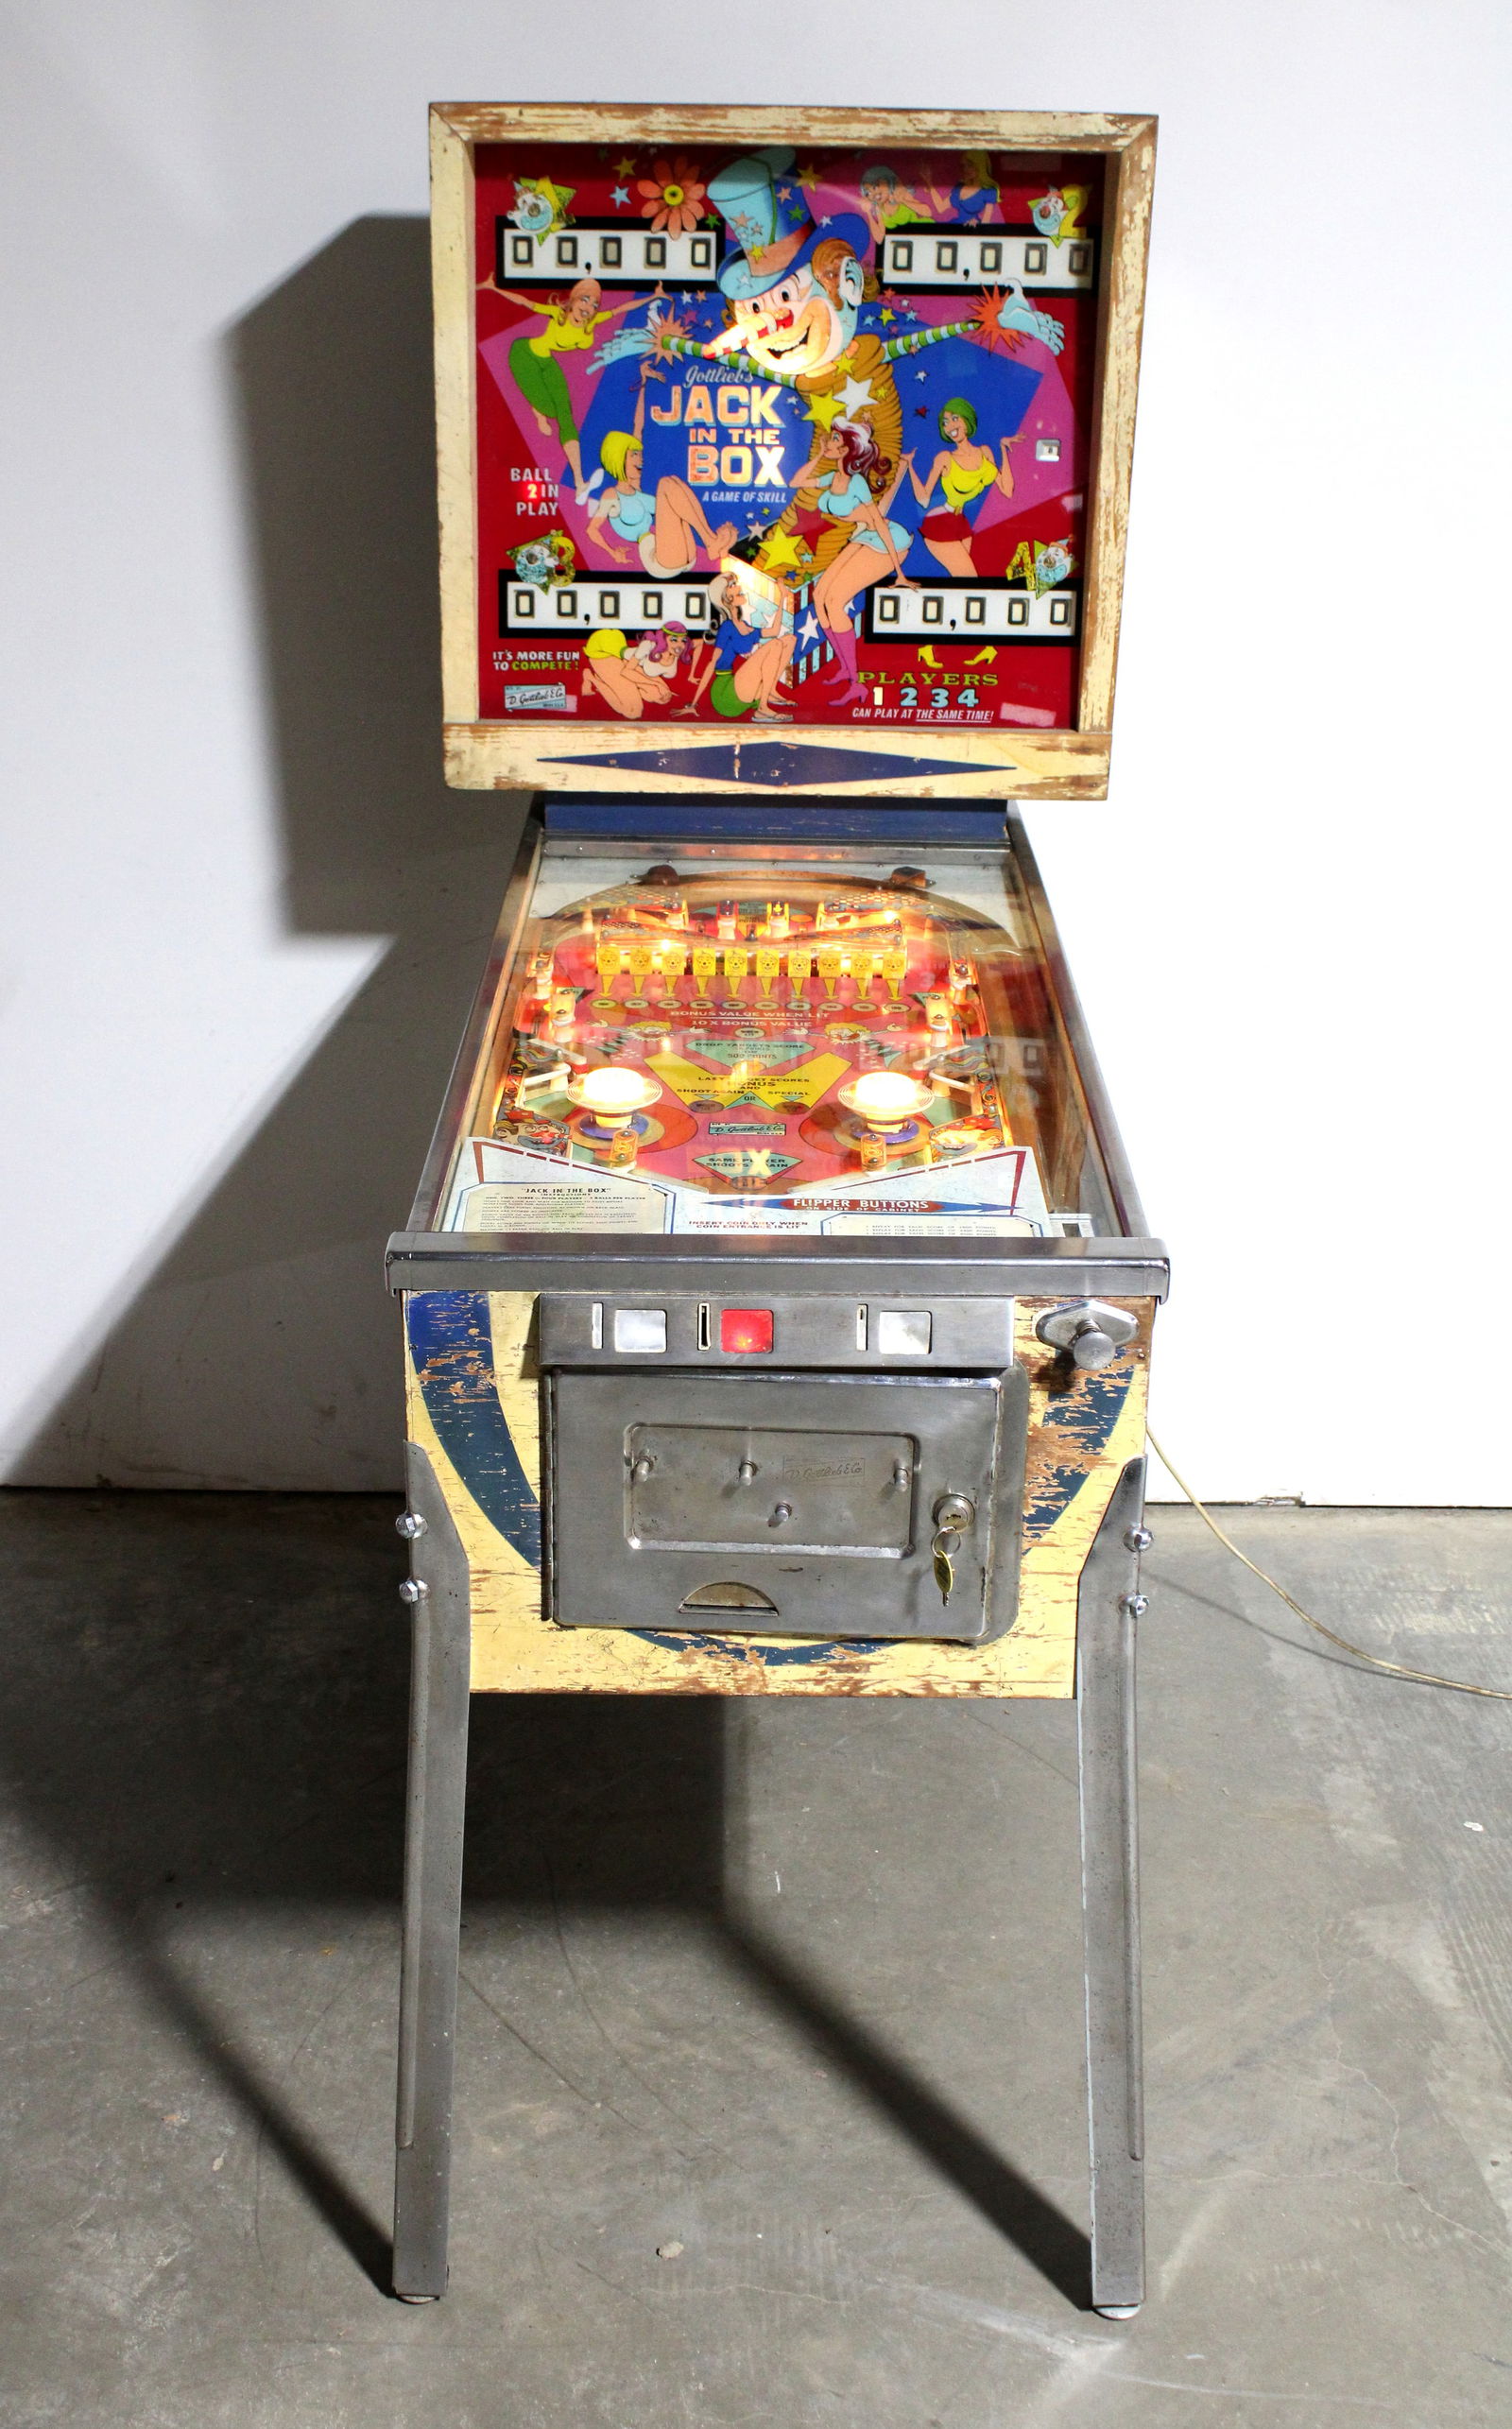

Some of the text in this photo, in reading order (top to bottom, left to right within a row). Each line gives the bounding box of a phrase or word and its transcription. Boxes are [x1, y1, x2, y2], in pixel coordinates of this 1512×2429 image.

[683, 365, 753, 388] Gottlieb's
[650, 385, 786, 428] JACK
[689, 427, 781, 445] IN THE
[687, 444, 788, 488] BOX
[510, 467, 553, 482] BALL
[527, 483, 559, 499] 2 IN
[702, 491, 787, 504] A GAME OF SKILL
[516, 501, 558, 516] PLAY
[492, 649, 580, 661] IT'S MORE FUN
[493, 661, 509, 671] TO
[857, 671, 999, 686] PLAYERS
[872, 686, 979, 708] 1 2 3 4
[852, 707, 994, 721] CAN PLAY AT THE SAME TIME!
[793, 1199, 929, 1209] FLIPPER BUTTONS
